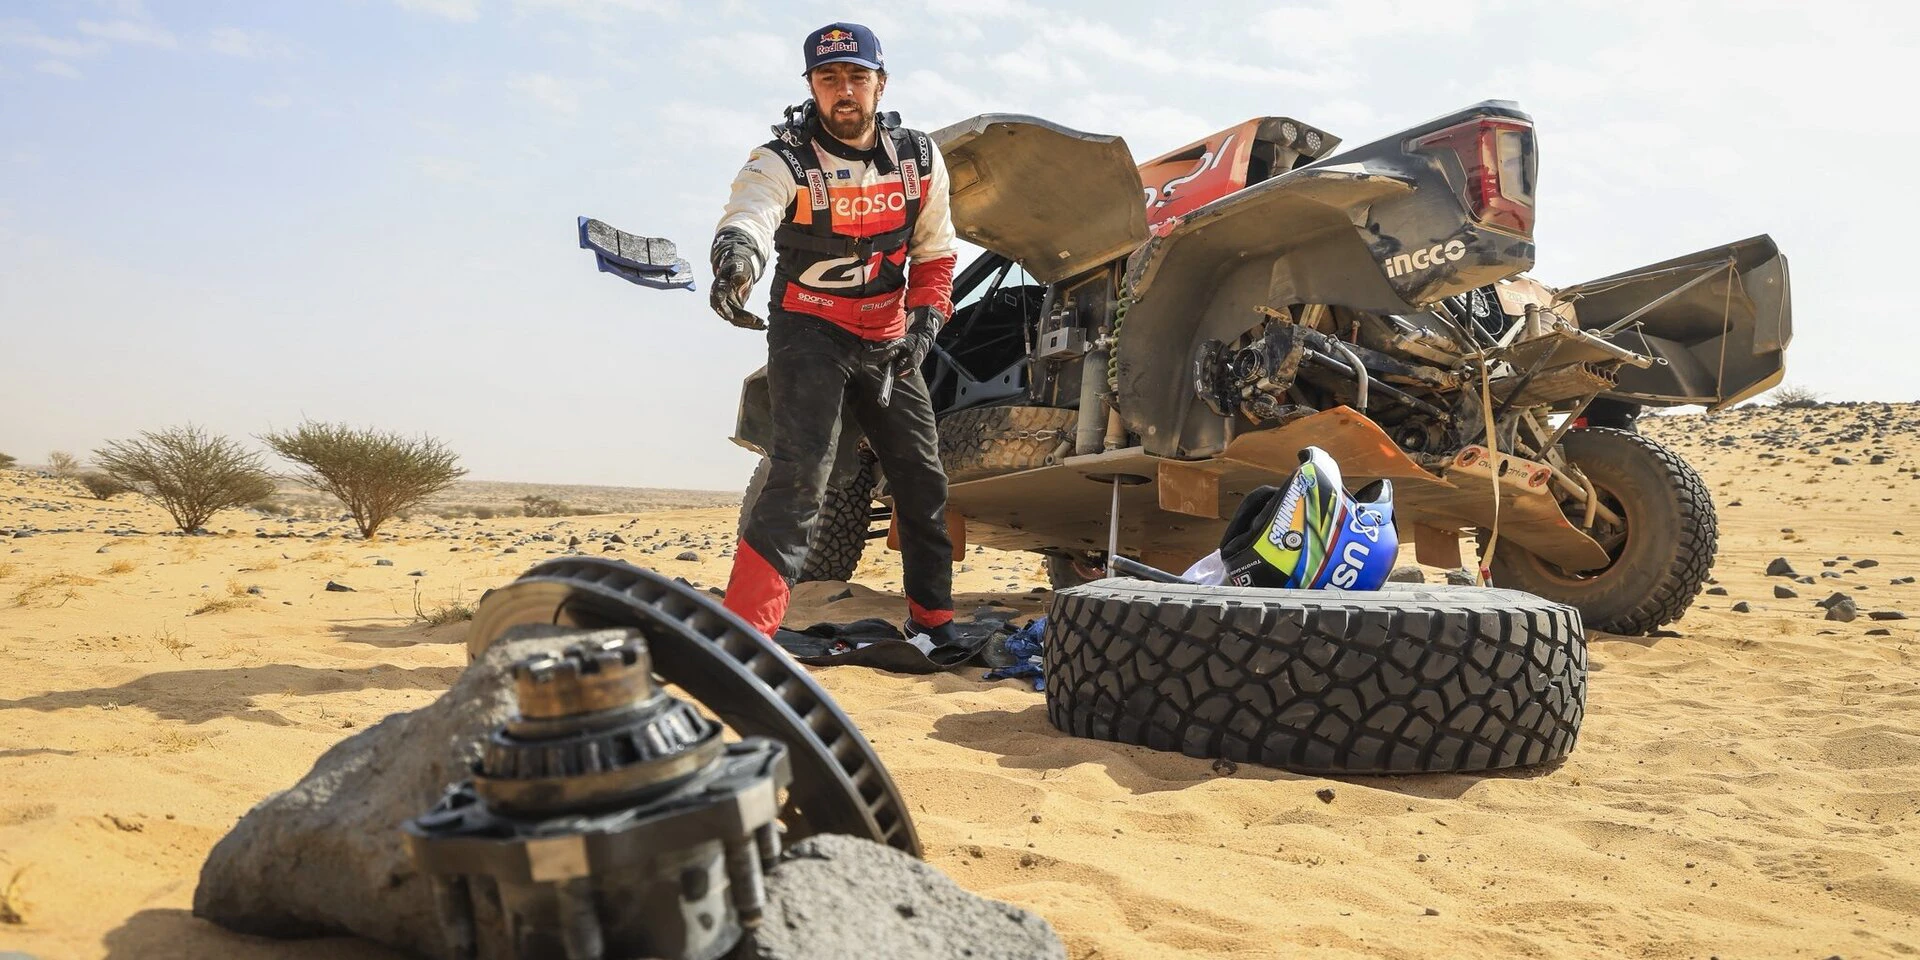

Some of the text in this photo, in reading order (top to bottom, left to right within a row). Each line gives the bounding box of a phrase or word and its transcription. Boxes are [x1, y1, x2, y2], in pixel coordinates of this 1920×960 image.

[816, 41, 858, 56] Red Bull
[780, 148, 806, 179] sparco
[919, 136, 930, 168] sparco
[811, 173, 825, 205] SIMPSON
[905, 164, 917, 195] SIMPSON
[830, 191, 906, 221] epso
[798, 291, 834, 308] sparco
[1241, 559, 1262, 570] TOYOTA
